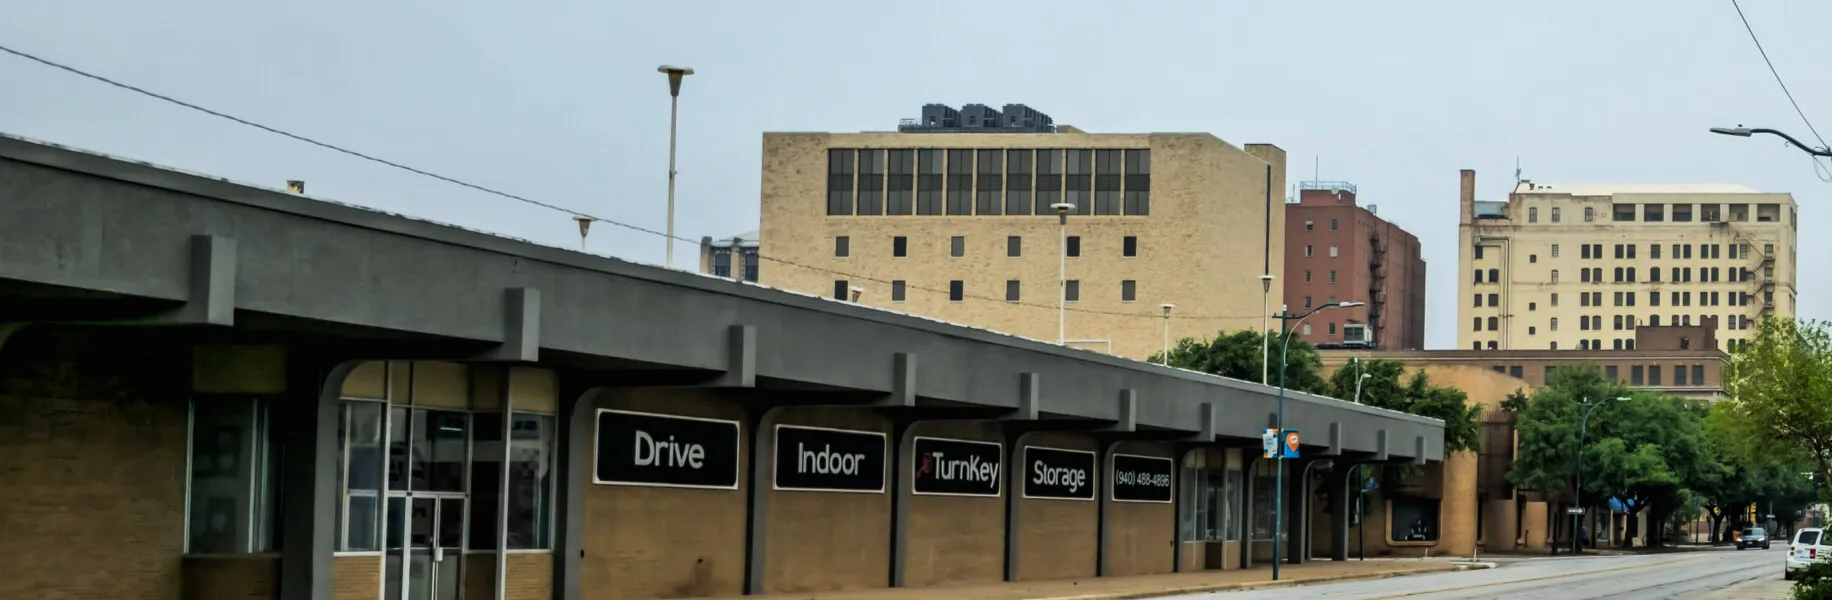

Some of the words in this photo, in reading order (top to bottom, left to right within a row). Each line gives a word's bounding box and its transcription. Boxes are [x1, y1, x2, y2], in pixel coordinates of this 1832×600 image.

[634, 430, 705, 469] Drive
[798, 442, 865, 475] Indoor
[932, 452, 999, 488] TurnKey
[1033, 459, 1086, 493] Storage
[1115, 468, 1136, 487] (940)
